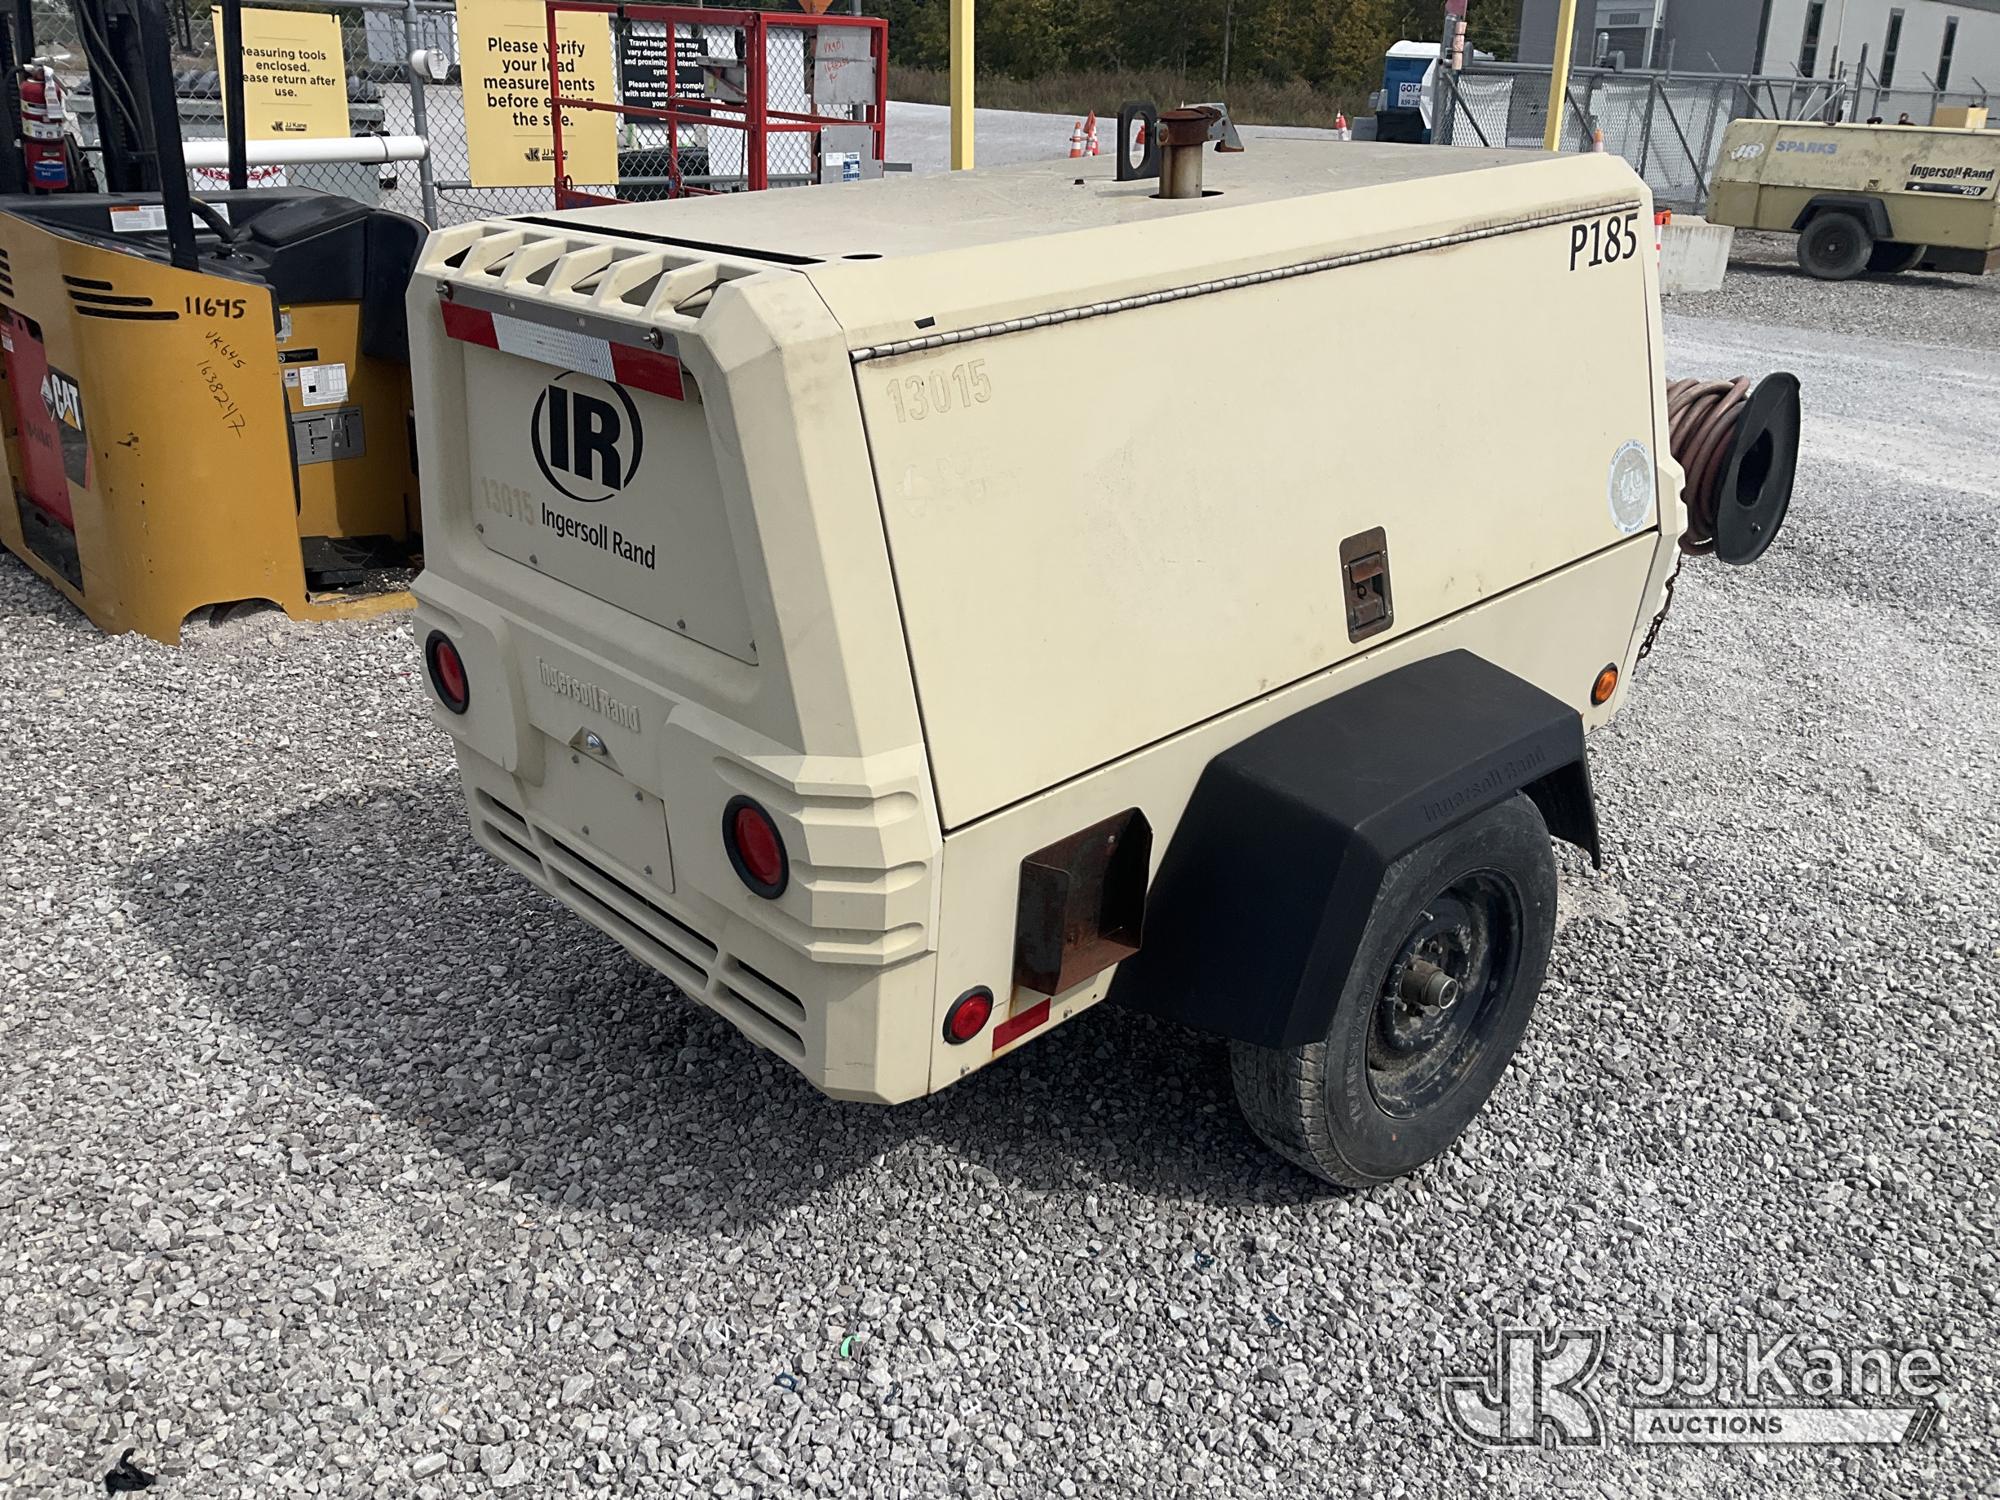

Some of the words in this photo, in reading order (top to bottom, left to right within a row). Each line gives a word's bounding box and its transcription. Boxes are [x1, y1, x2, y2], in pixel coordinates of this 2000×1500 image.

[488, 37, 538, 53] Please
[629, 39, 649, 47] Travel
[299, 49, 327, 60] tools
[256, 61, 310, 72] enclosed.
[502, 59, 537, 73] your
[638, 59, 668, 67] proximity
[242, 74, 269, 83] ease
[272, 74, 307, 84] return
[310, 75, 336, 86] after
[484, 77, 595, 91] measureents
[628, 80, 649, 88] Please
[650, 81, 668, 90] verify
[274, 87, 298, 97] use.
[487, 93, 538, 108] before
[652, 100, 667, 108] your
[513, 112, 538, 126] the
[1776, 140, 1837, 155] SPARKS
[1963, 187, 1981, 195] 250
[1570, 212, 1638, 271] P185
[185, 296, 247, 319] 11645
[887, 358, 992, 424] 13015
[51, 374, 82, 431] CAT
[197, 359, 246, 438] 1638247
[548, 384, 621, 491] IR
[481, 476, 534, 526] 13015
[541, 502, 608, 550] Ingersoll
[612, 530, 656, 570] Rand
